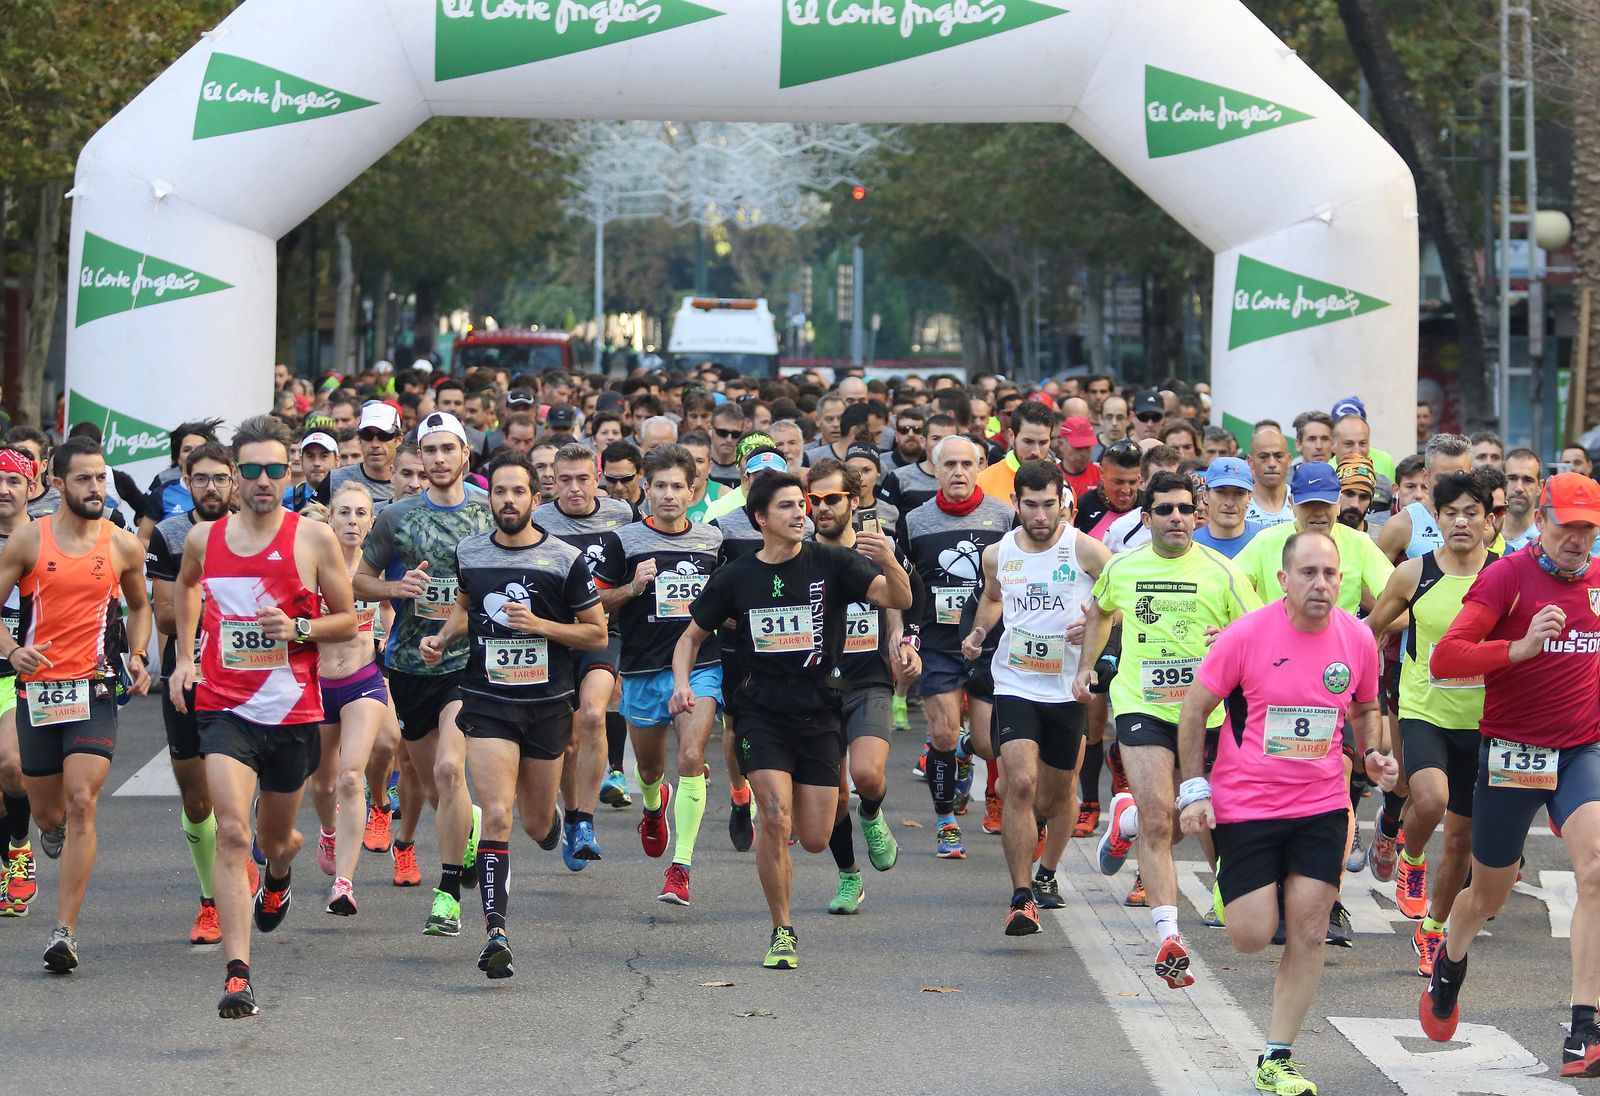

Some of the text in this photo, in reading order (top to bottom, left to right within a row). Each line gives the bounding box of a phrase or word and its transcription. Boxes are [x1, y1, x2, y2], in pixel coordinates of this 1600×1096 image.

[442, 0, 474, 19] El
[481, 0, 551, 21] Corte
[786, 0, 1007, 38] El Corte Inglés
[203, 80, 341, 115] El Corte Inglés
[1147, 96, 1282, 130] El Corte Inglés
[81, 262, 200, 297] El Corte Inglés
[1234, 285, 1361, 319] El Corte Inglés
[106, 421, 171, 456] Inglés
[666, 583, 702, 599] 256
[1013, 595, 1065, 612] INDEA
[761, 615, 800, 633] 311
[232, 631, 276, 649] 388
[1024, 640, 1048, 657] 19
[1543, 637, 1600, 653] lus50
[497, 648, 537, 666] 375
[1152, 667, 1194, 686] 395
[38, 689, 78, 705] 464
[1294, 717, 1310, 737] 8
[1498, 740, 1517, 748] SUBIDA
[1501, 751, 1547, 770] 135
